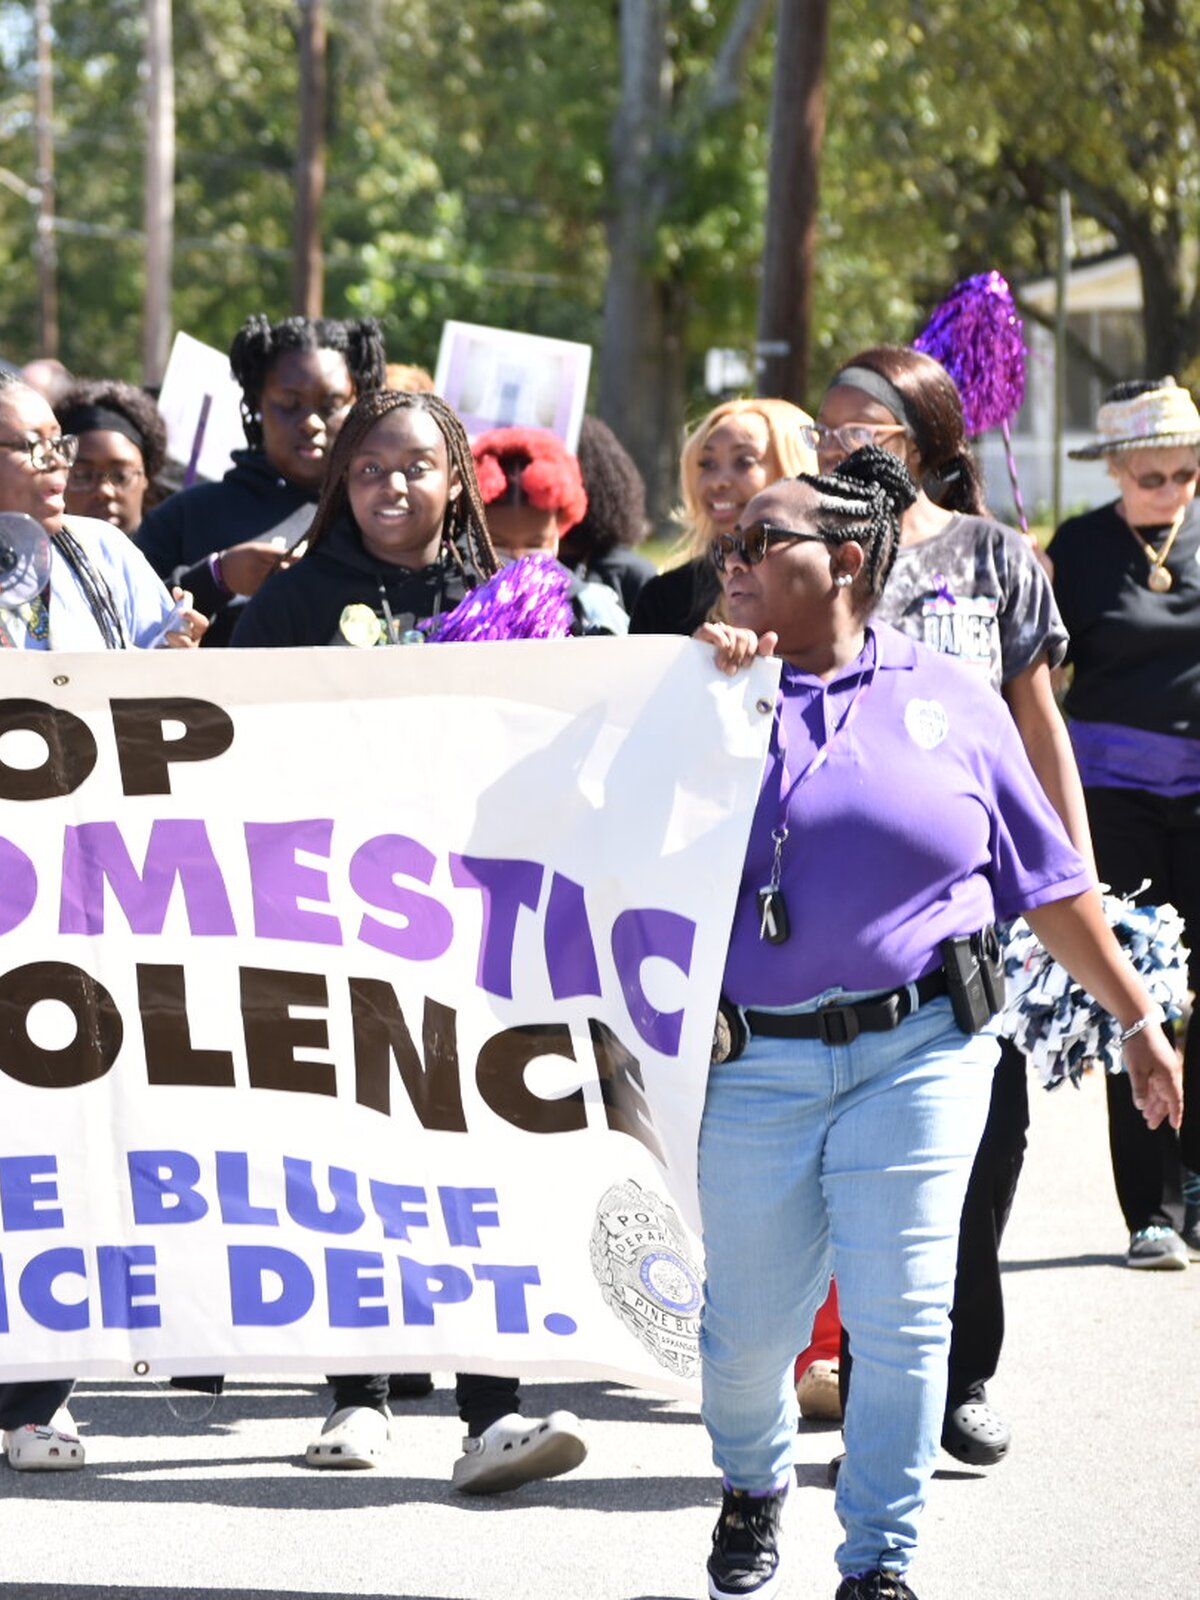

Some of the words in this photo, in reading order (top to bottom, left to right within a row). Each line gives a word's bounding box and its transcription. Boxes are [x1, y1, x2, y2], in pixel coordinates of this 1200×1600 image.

[127, 1150, 500, 1247] BLUFF
[228, 1245, 578, 1337] DEPT.
[634, 1297, 668, 1327] PINE
